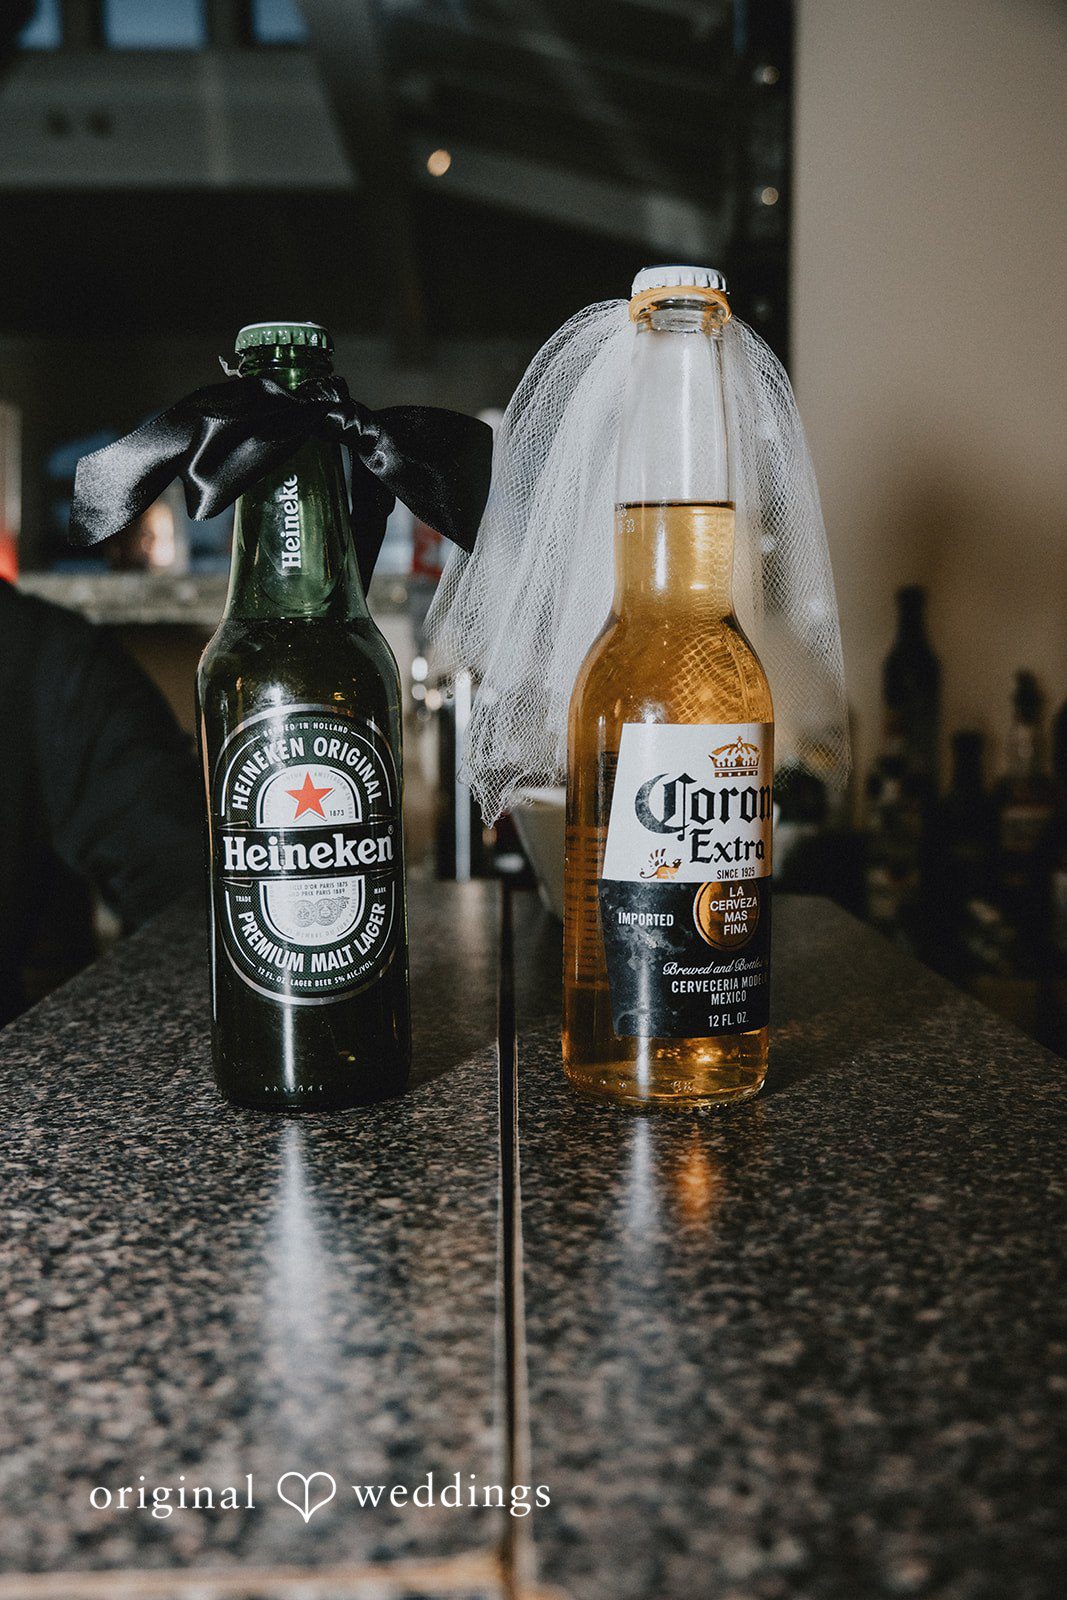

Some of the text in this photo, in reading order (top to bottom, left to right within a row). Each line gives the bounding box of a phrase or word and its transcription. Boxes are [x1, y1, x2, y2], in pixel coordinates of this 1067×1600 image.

[300, 722, 309, 730] IN
[313, 722, 348, 734] HOLLAND
[232, 737, 305, 810] HEINEKEN
[313, 737, 382, 804] ORIGINAL
[222, 833, 394, 872] Heineken
[689, 828, 765, 864] Extra
[716, 866, 755, 880] SINCE 1925
[729, 886, 744, 897] LA
[709, 897, 758, 912] CERVEZA
[618, 911, 674, 927] IMPORTED
[724, 911, 748, 923] MAS
[723, 923, 748, 936] FINA
[238, 902, 386, 973] PREMIUM MALT LAGER
[662, 961, 714, 976] Brewed
[713, 960, 735, 974] and
[290, 979, 312, 987] LAGER
[314, 978, 332, 987] BEER
[334, 976, 345, 984] 5%
[671, 977, 739, 994] CERVECERIA
[711, 989, 747, 1006] MEXICO
[708, 1014, 719, 1028] 12
